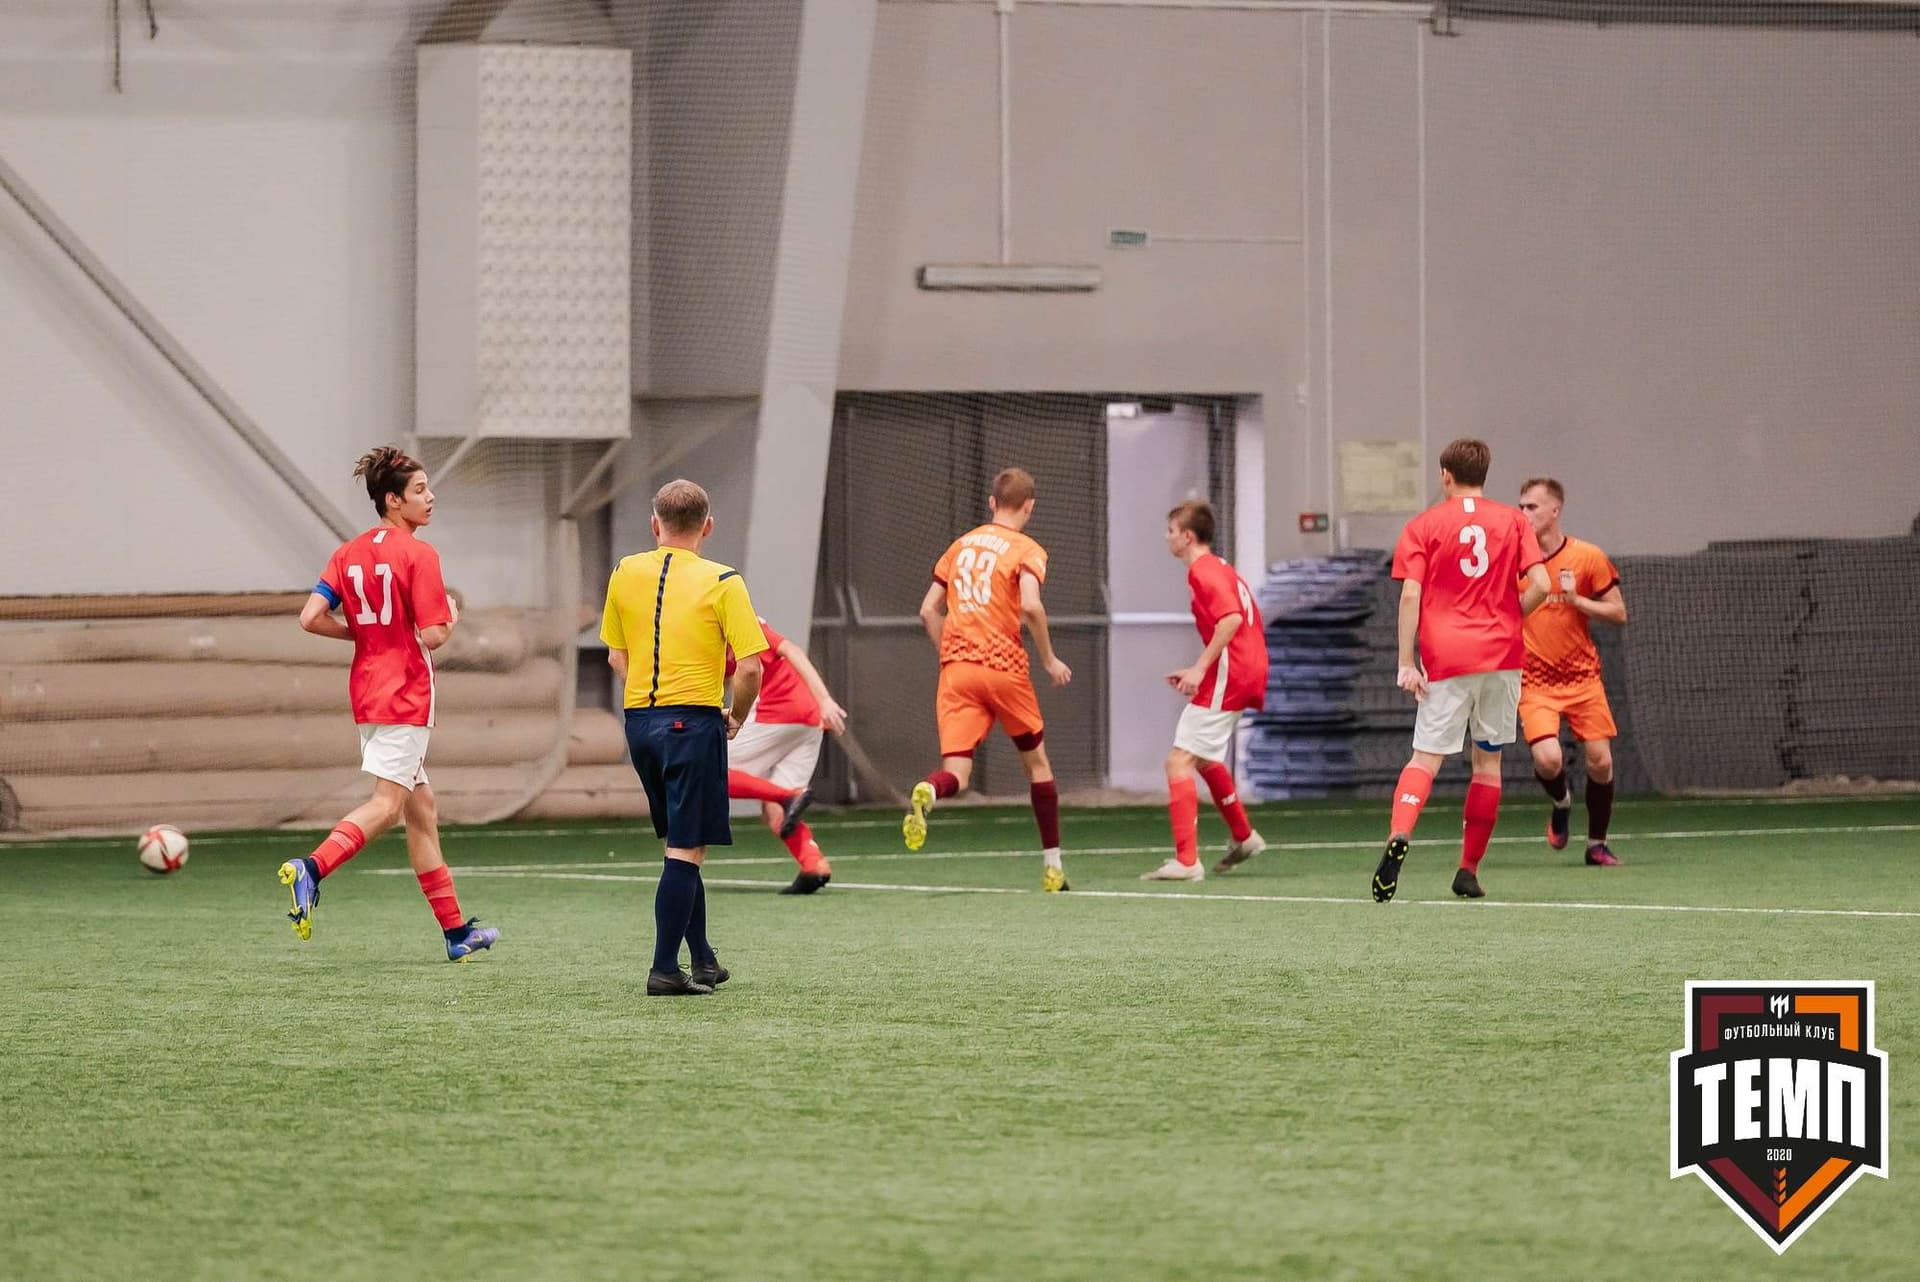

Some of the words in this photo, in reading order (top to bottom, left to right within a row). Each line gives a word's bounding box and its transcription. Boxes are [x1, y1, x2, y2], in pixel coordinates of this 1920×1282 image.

[954, 548, 997, 605] 33
[1459, 524, 1489, 578] 3
[347, 563, 393, 625] 17
